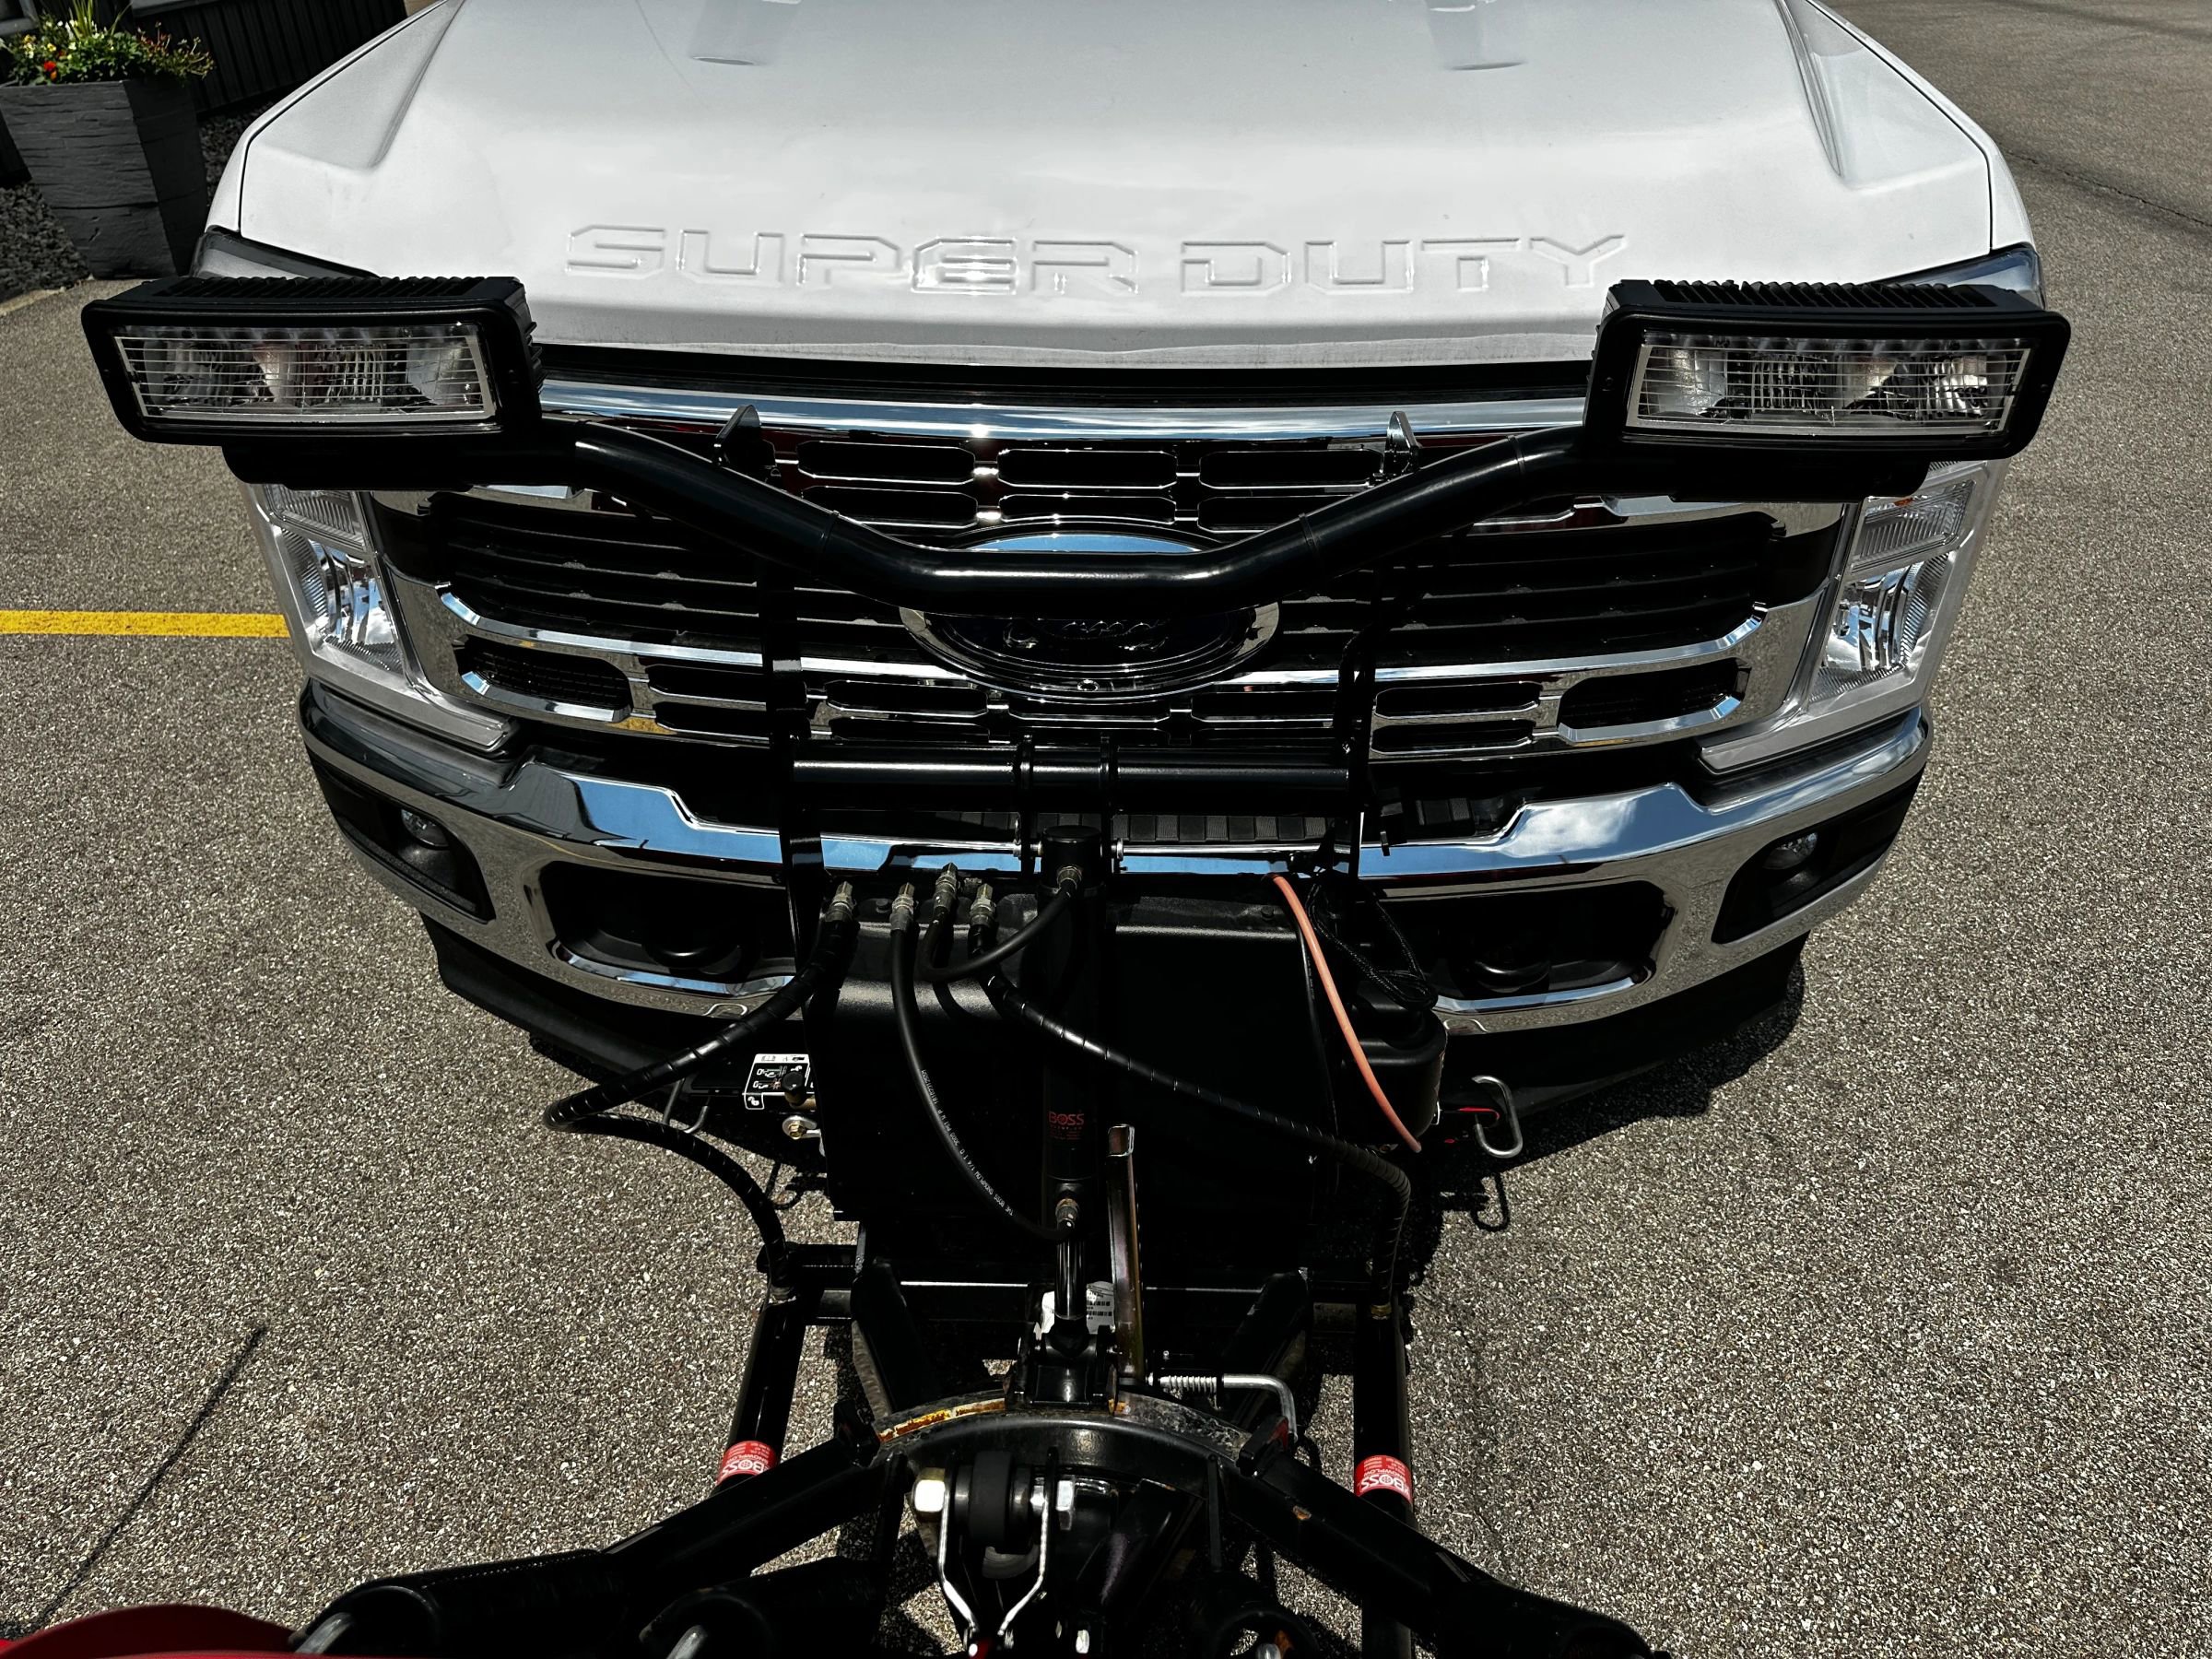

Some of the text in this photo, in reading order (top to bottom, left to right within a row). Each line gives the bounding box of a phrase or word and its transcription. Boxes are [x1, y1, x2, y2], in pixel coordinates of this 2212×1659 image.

[565, 224, 1627, 296] SUPER DUTY
[1048, 1111, 1084, 1125] BOSS
[1361, 1474, 1405, 1492] BOSS
